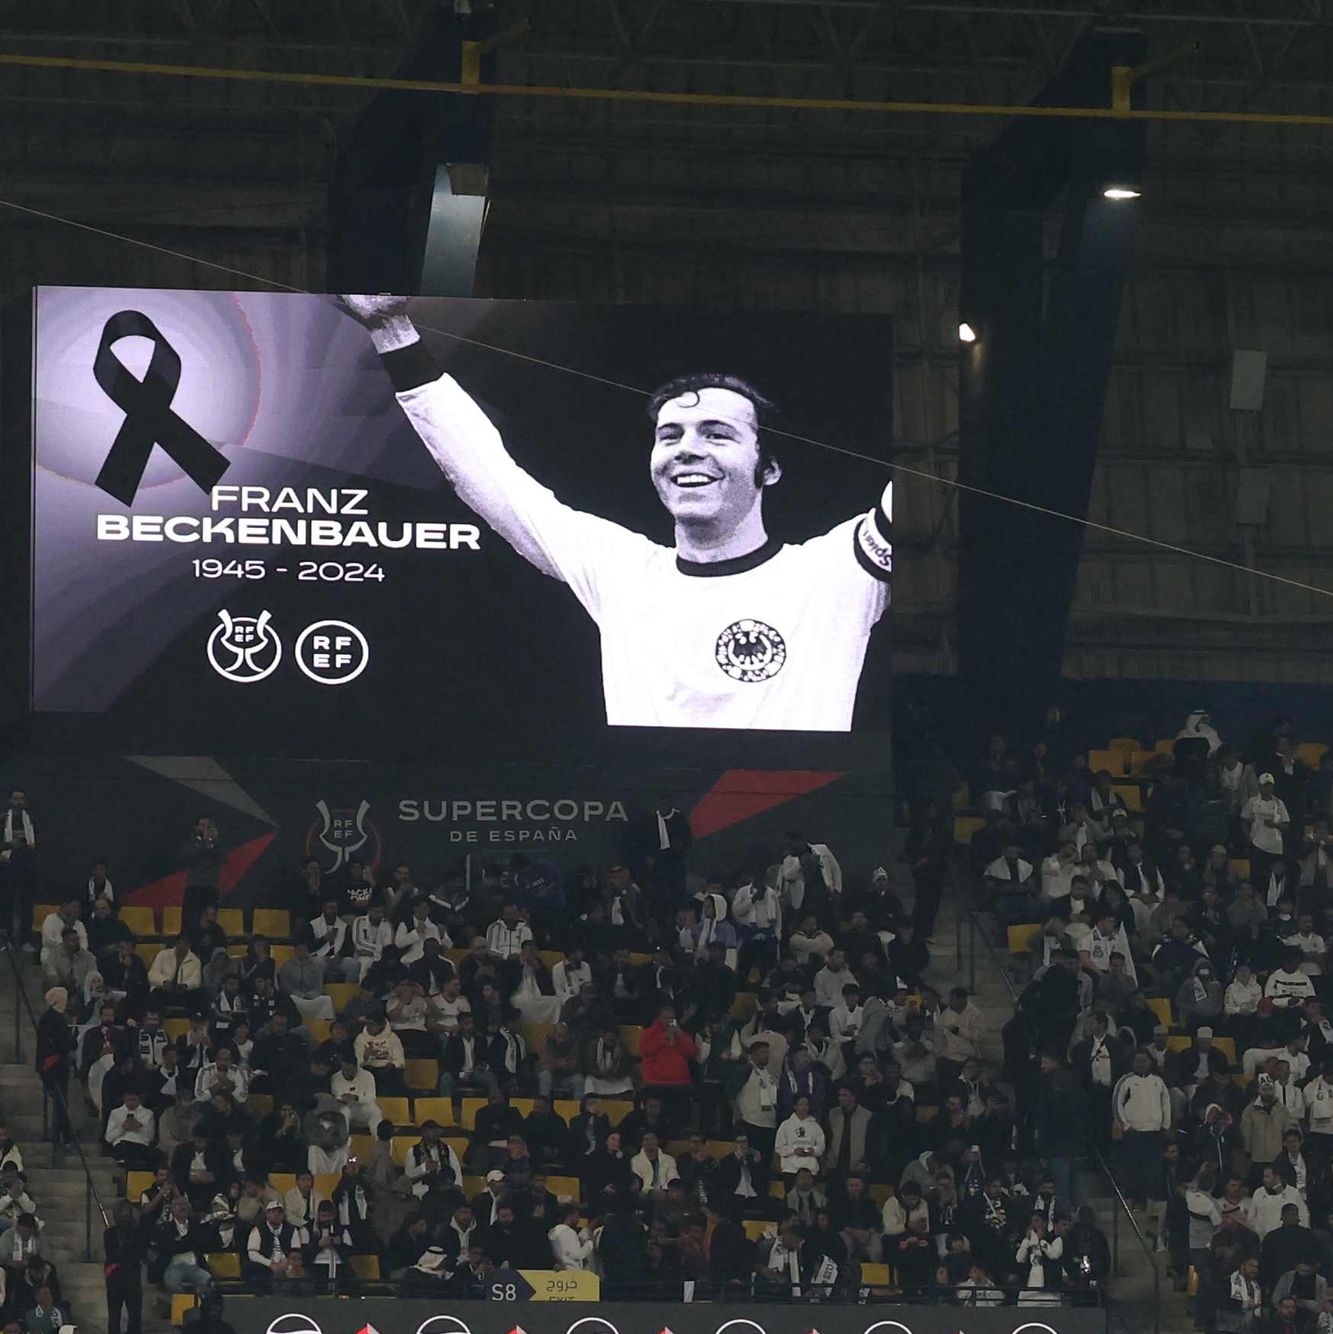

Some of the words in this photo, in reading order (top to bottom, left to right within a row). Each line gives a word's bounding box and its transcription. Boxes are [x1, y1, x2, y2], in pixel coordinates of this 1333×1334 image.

[211, 485, 369, 515] FRANZ
[97, 514, 481, 550] BECKENBAUER
[192, 558, 266, 580] 1945
[298, 561, 385, 582] 2024
[399, 799, 629, 822] SUPERCOPA
[450, 830, 478, 842] DE
[489, 826, 578, 842] ESPAÑA
[491, 1283, 517, 1301] S8
[546, 1277, 578, 1292] خروج
